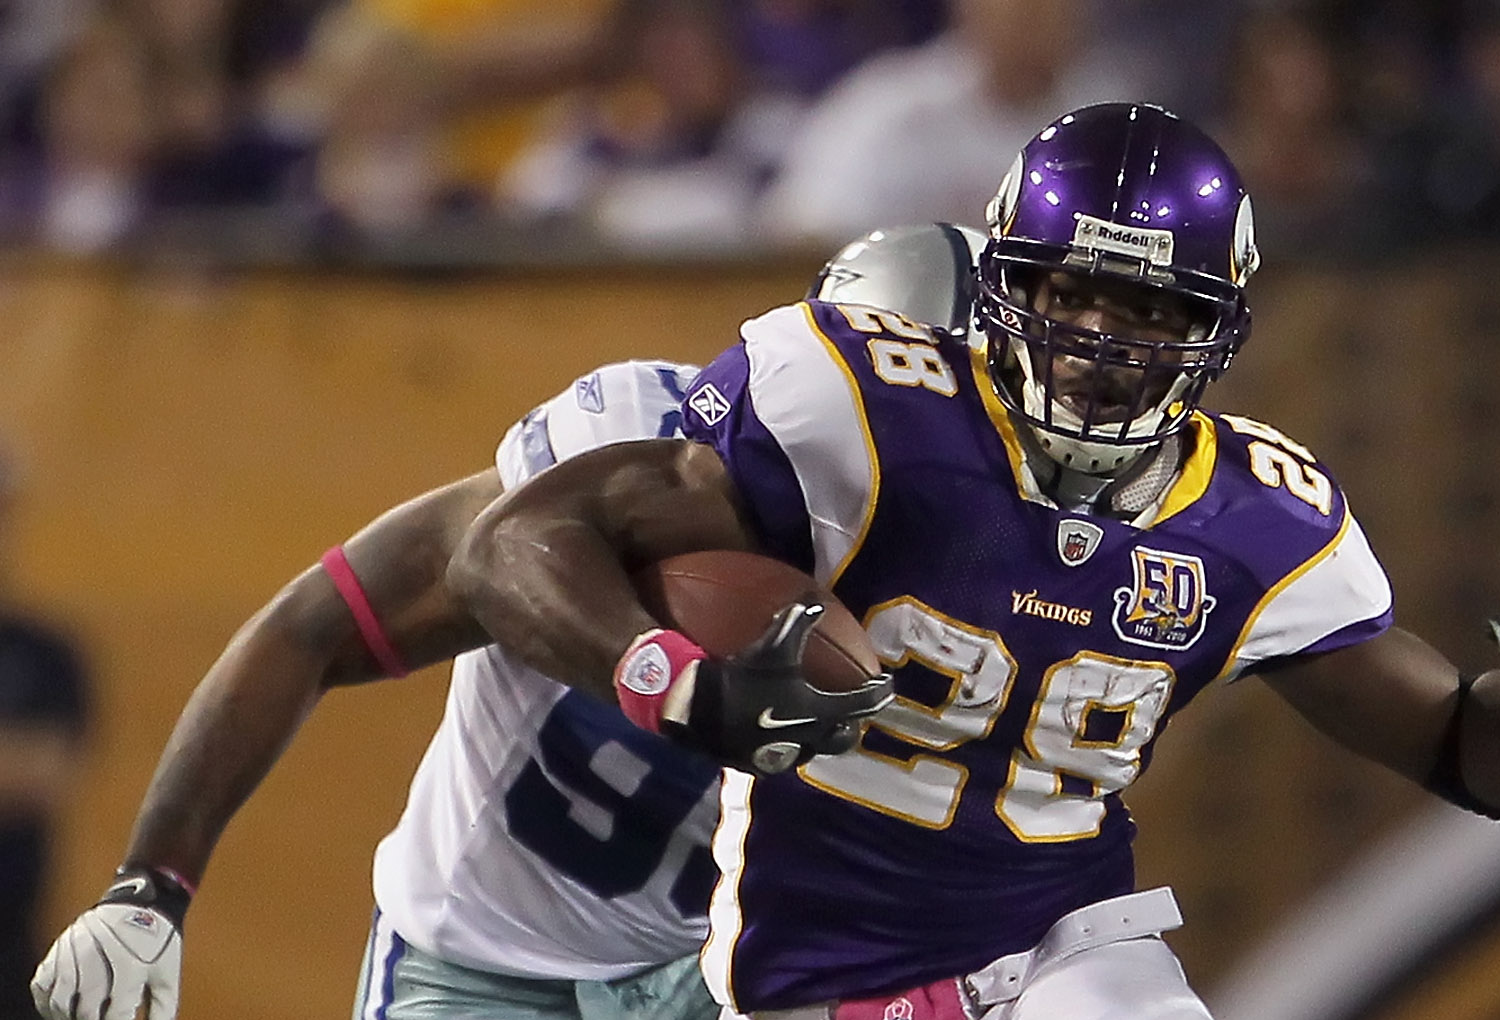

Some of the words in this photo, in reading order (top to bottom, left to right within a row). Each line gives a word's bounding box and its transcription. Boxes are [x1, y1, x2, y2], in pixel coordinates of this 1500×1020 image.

[1098, 226, 1149, 248] Riddell
[504, 686, 723, 918] 9
[797, 595, 1176, 844] 28
